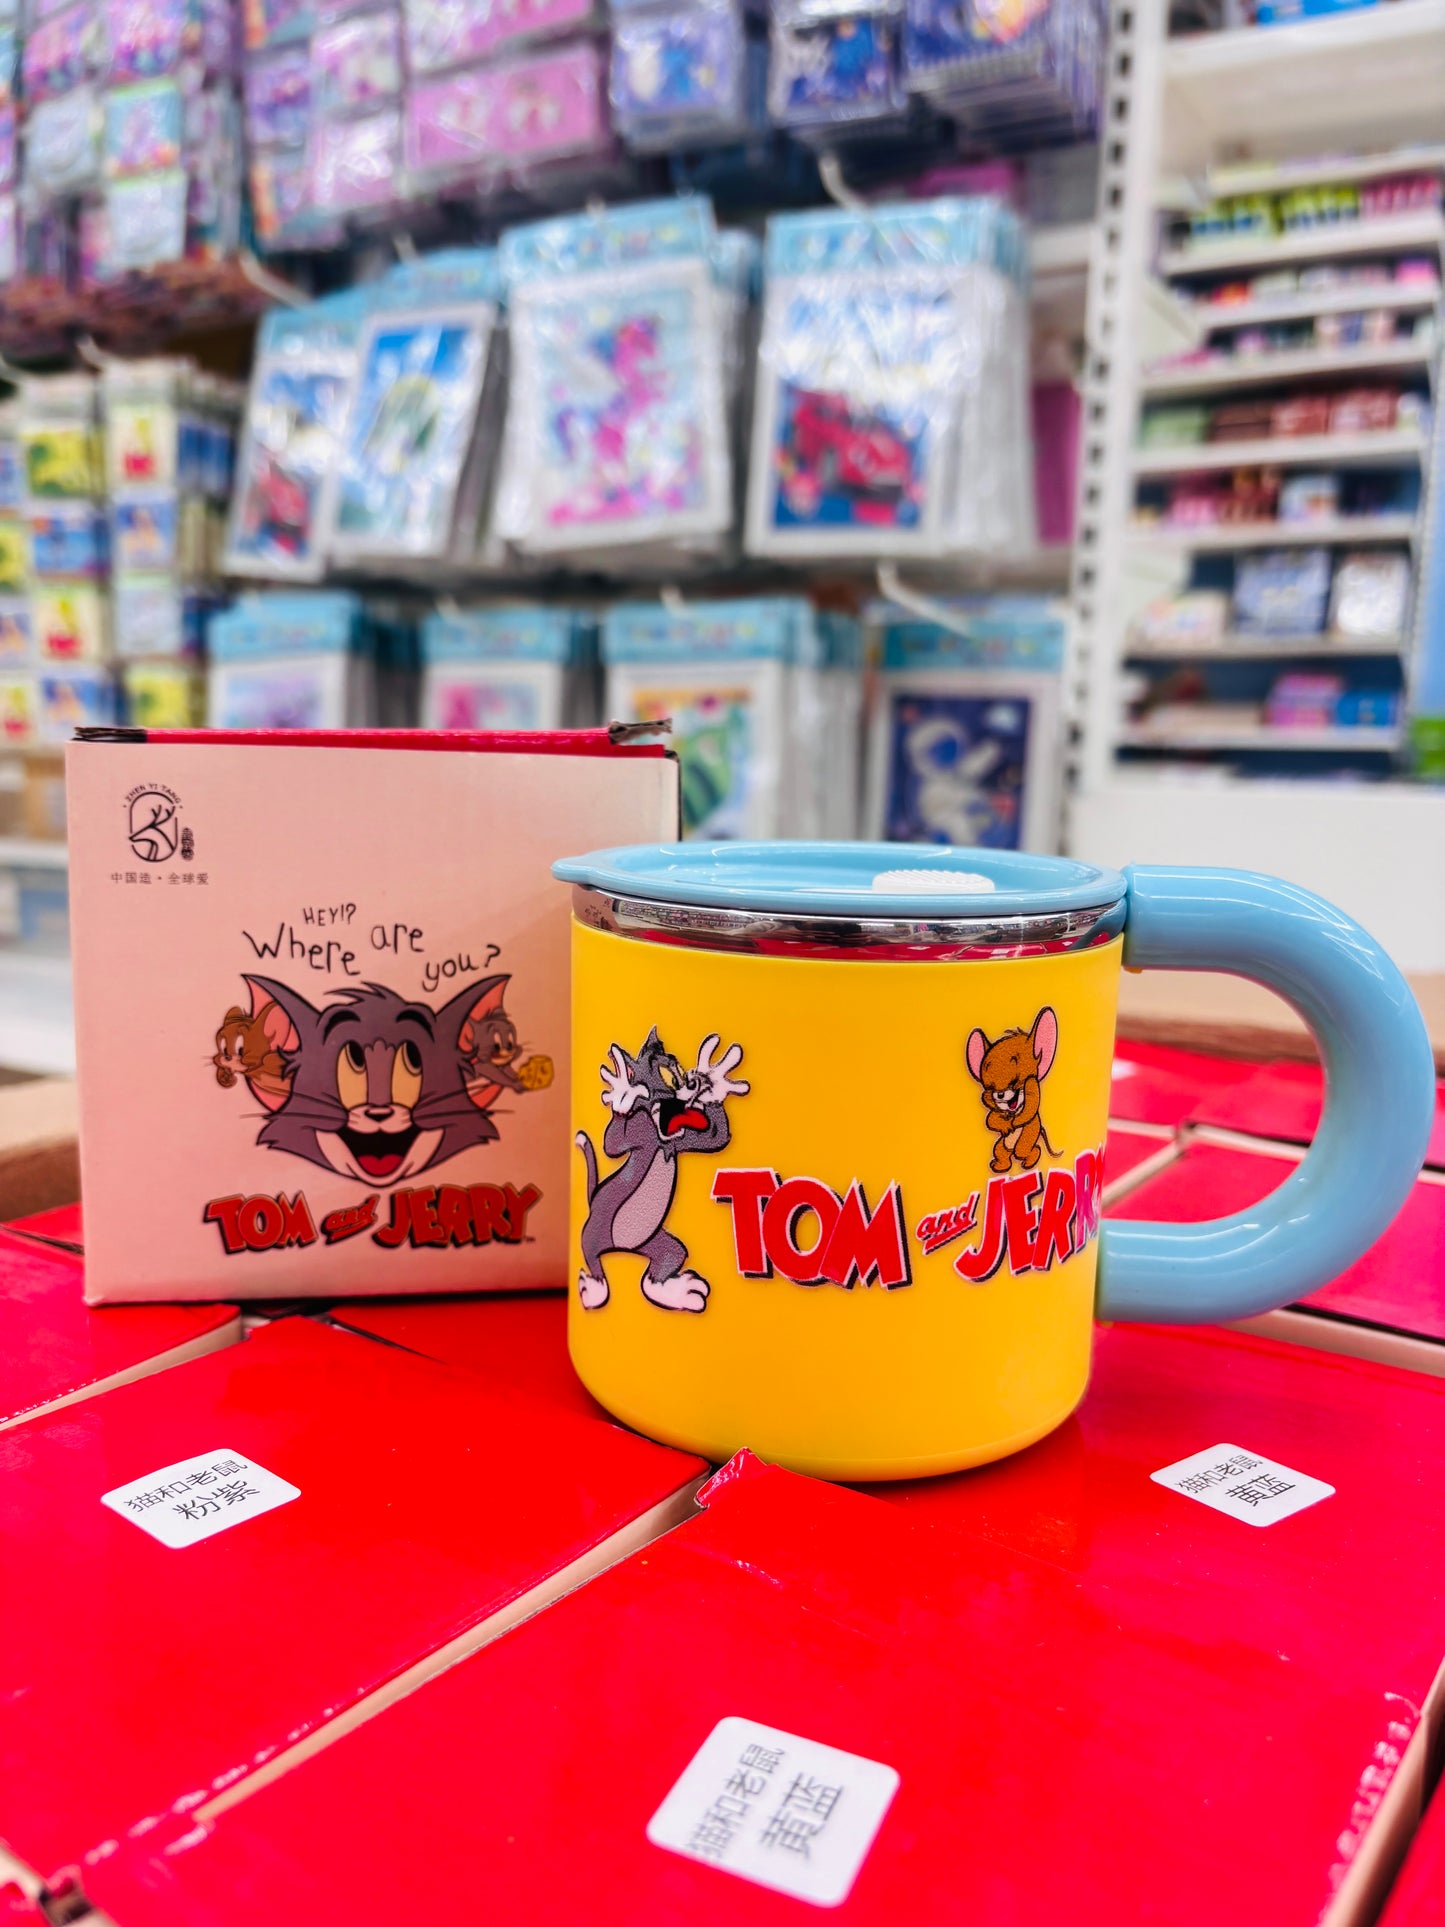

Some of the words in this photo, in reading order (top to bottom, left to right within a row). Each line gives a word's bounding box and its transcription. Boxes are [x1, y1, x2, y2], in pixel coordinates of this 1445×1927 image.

[302, 902, 357, 926] HEY!?
[242, 922, 361, 976] Where
[370, 923, 425, 954] are
[421, 944, 501, 993] you?
[202, 1190, 319, 1255] TOM
[320, 1193, 381, 1245] and
[371, 1181, 544, 1249] JERRY
[709, 1167, 914, 1291] TOM
[915, 1190, 981, 1256] and
[123, 1459, 249, 1513] 猫和老鼠
[172, 1479, 261, 1521] 粉紫
[1173, 1454, 1264, 1494] 猫和老鼠
[1224, 1472, 1297, 1507] 黄蓝
[685, 1742, 787, 1863] 猫和老鼠
[758, 1772, 845, 1861] 黄蓝
